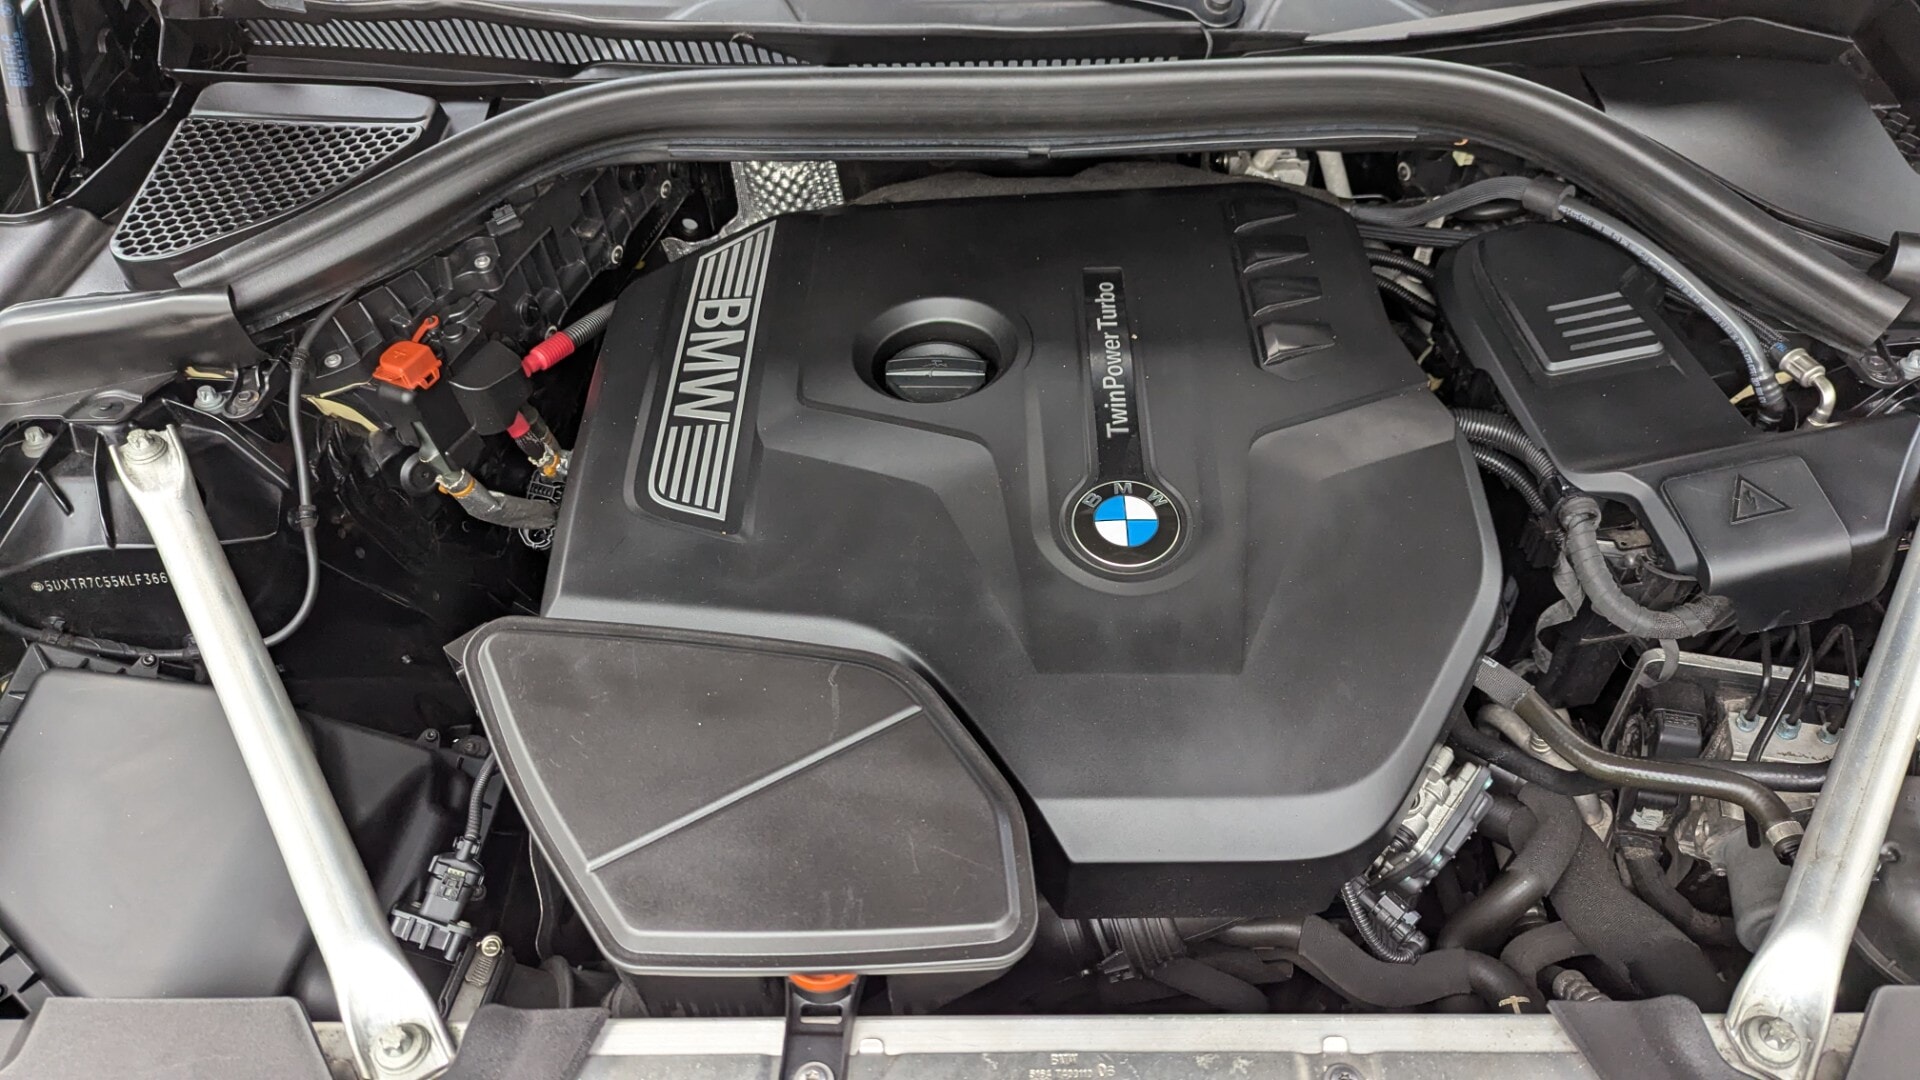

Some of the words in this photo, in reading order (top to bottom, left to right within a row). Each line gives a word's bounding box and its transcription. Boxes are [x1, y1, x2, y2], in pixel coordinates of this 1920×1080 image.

[1095, 281, 1118, 331] Turbo
[673, 298, 751, 422] BMW
[1102, 332, 1129, 438] TwinPower
[1082, 482, 1168, 508] BMW
